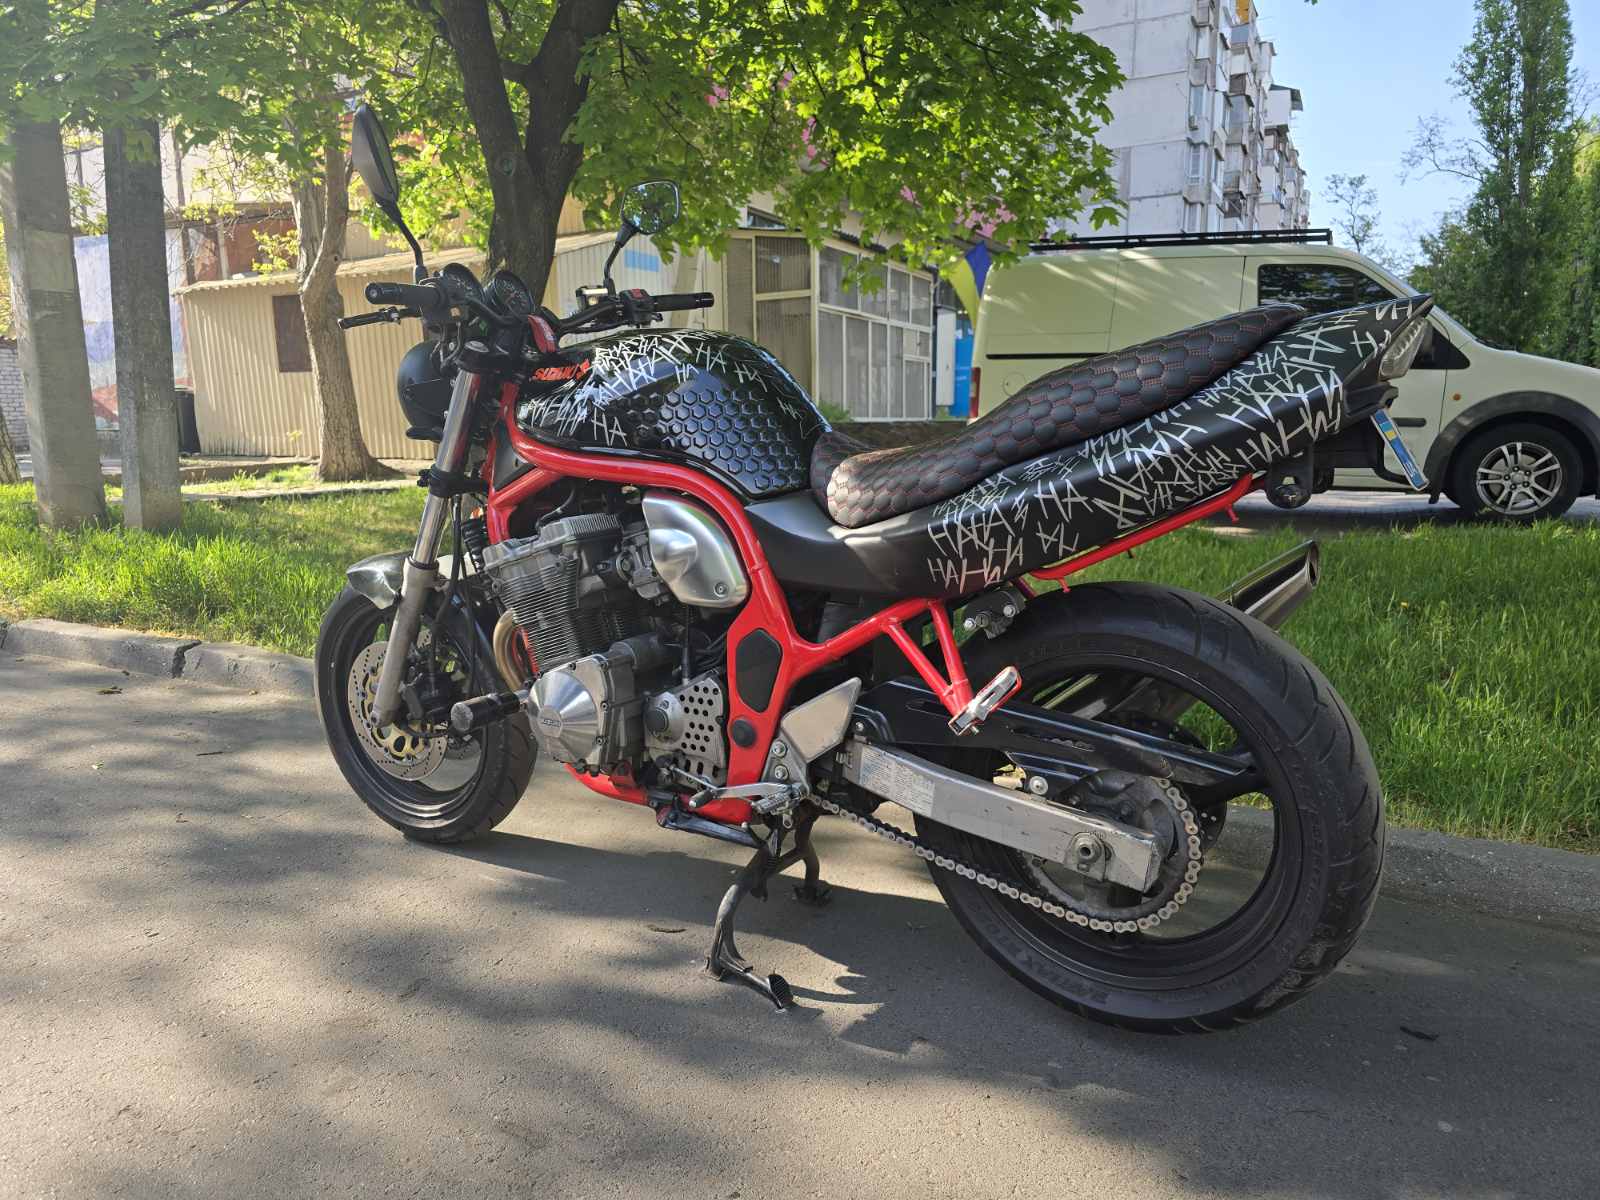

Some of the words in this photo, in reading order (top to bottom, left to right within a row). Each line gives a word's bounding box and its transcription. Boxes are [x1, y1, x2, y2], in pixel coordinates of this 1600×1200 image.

[674, 362, 700, 384] HA
[591, 406, 628, 447] HA
[1033, 478, 1094, 523] HA
[927, 557, 960, 589] HA
